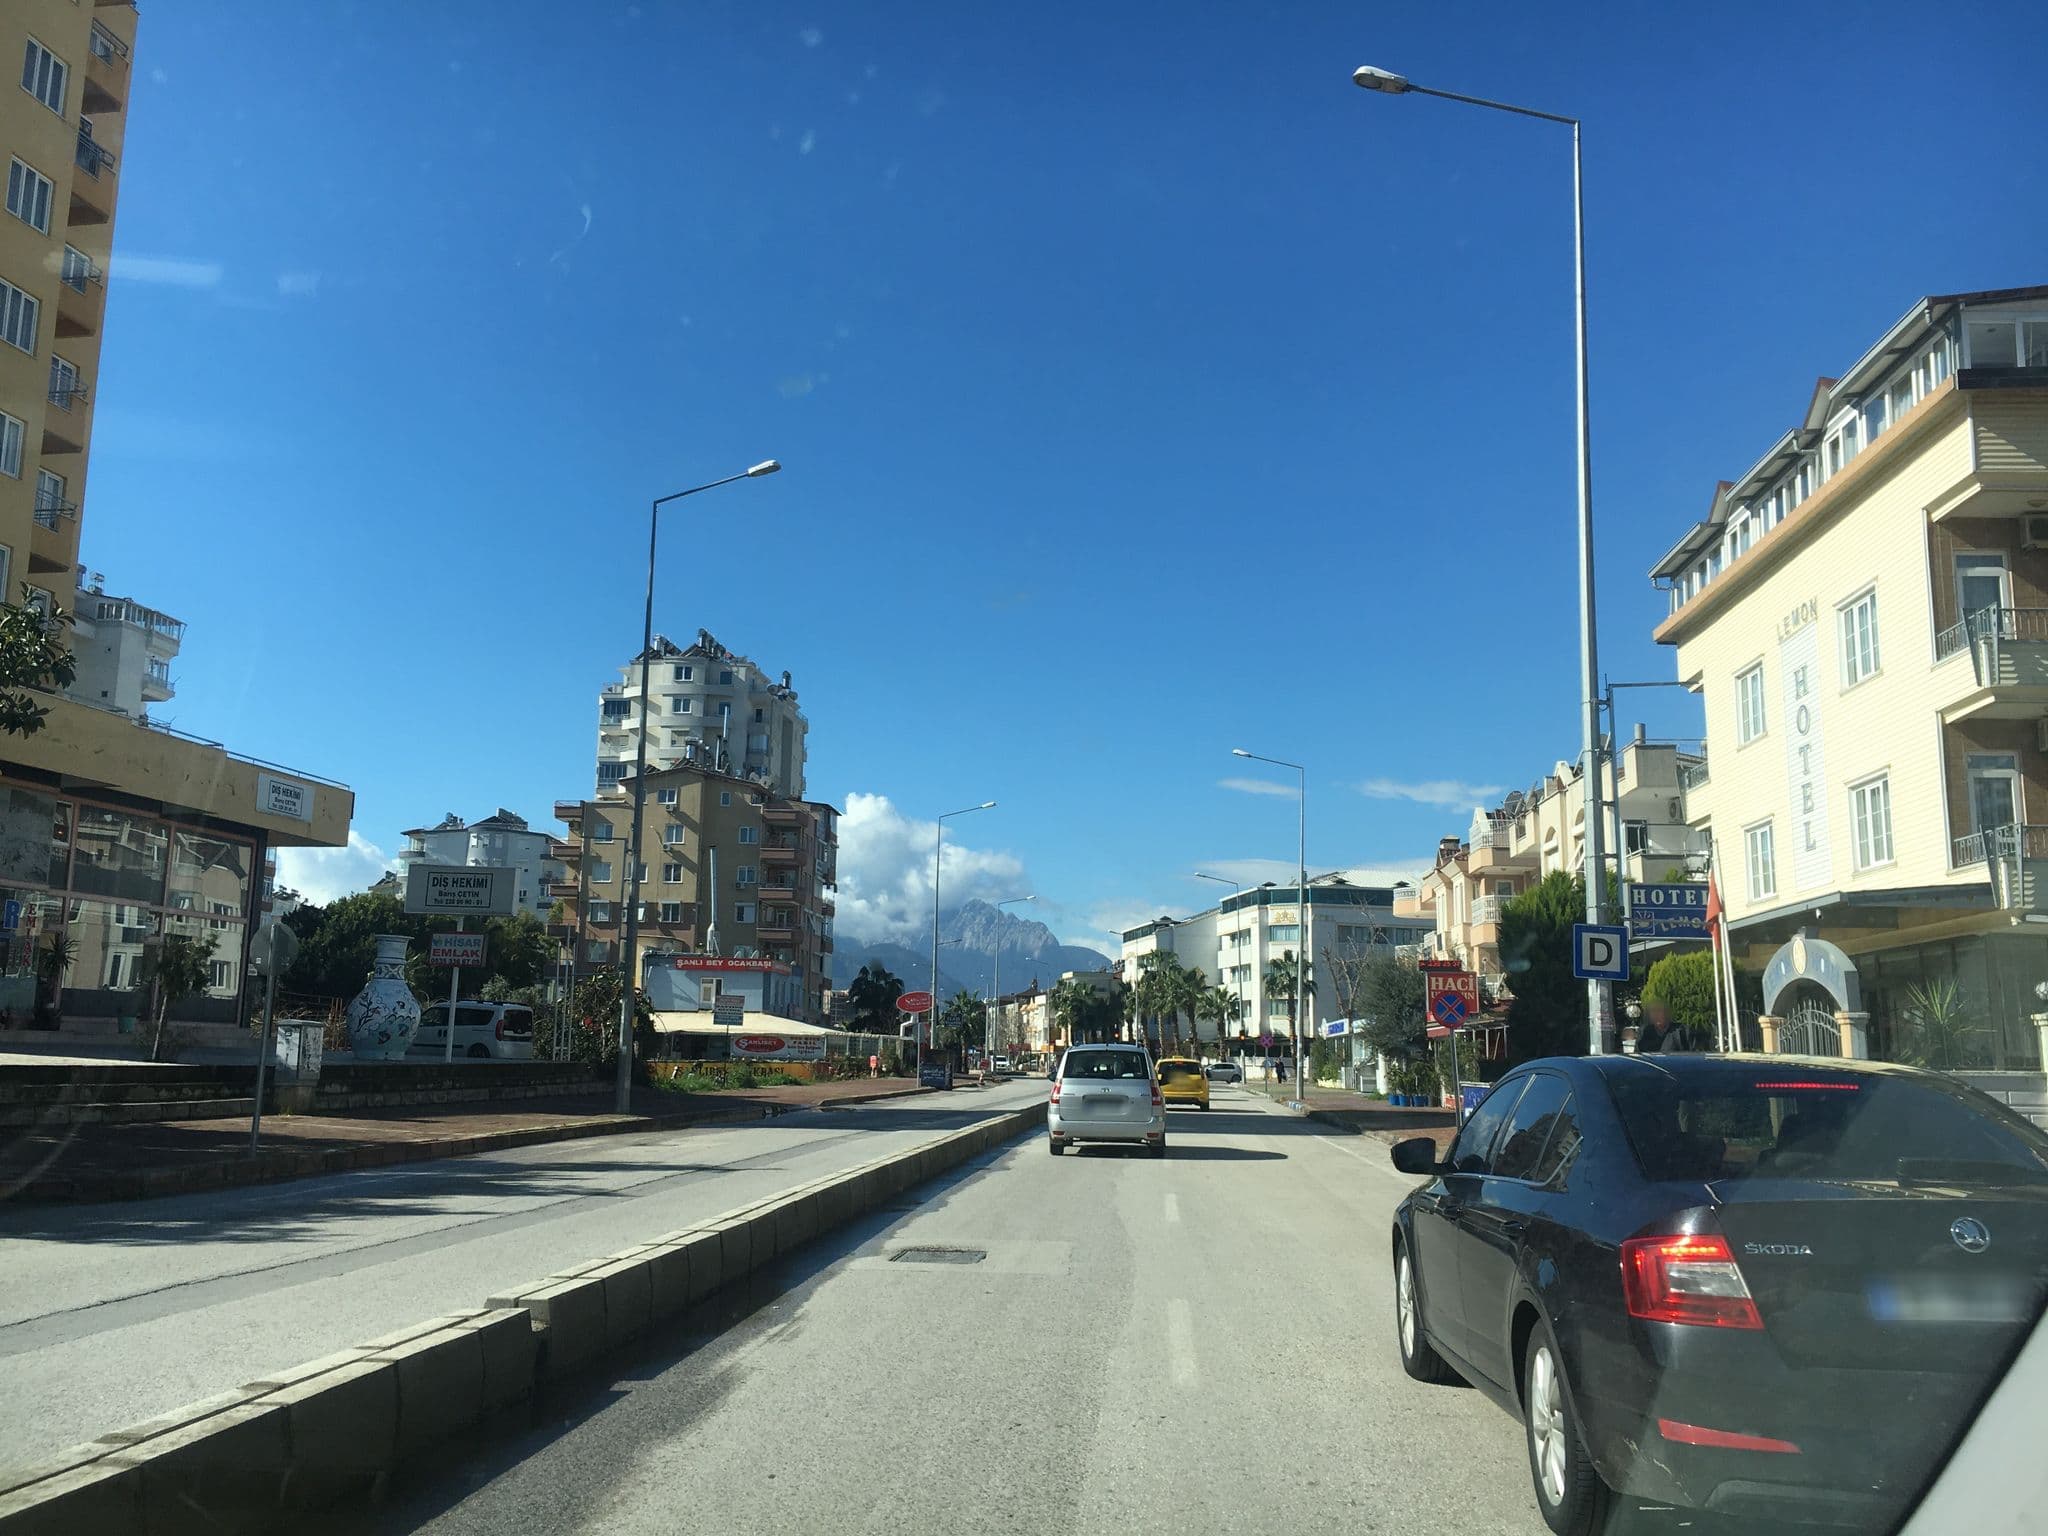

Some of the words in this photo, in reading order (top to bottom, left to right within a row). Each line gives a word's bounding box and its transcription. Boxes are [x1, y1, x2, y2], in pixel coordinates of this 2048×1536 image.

[1776, 596, 1818, 642] LEMON
[1793, 664, 1817, 852] HOTEL
[432, 875, 449, 891] DİŞ
[452, 876, 488, 888] HEKİMİ
[432, 949, 480, 957] EMLAK
[1589, 937, 1612, 966] D
[676, 959, 703, 968] ŞANLI
[706, 959, 724, 967] BEY
[727, 960, 772, 969] OCAKBAŞI
[1430, 974, 1475, 991] HACİ
[1745, 1242, 1814, 1255] ŠKODA
